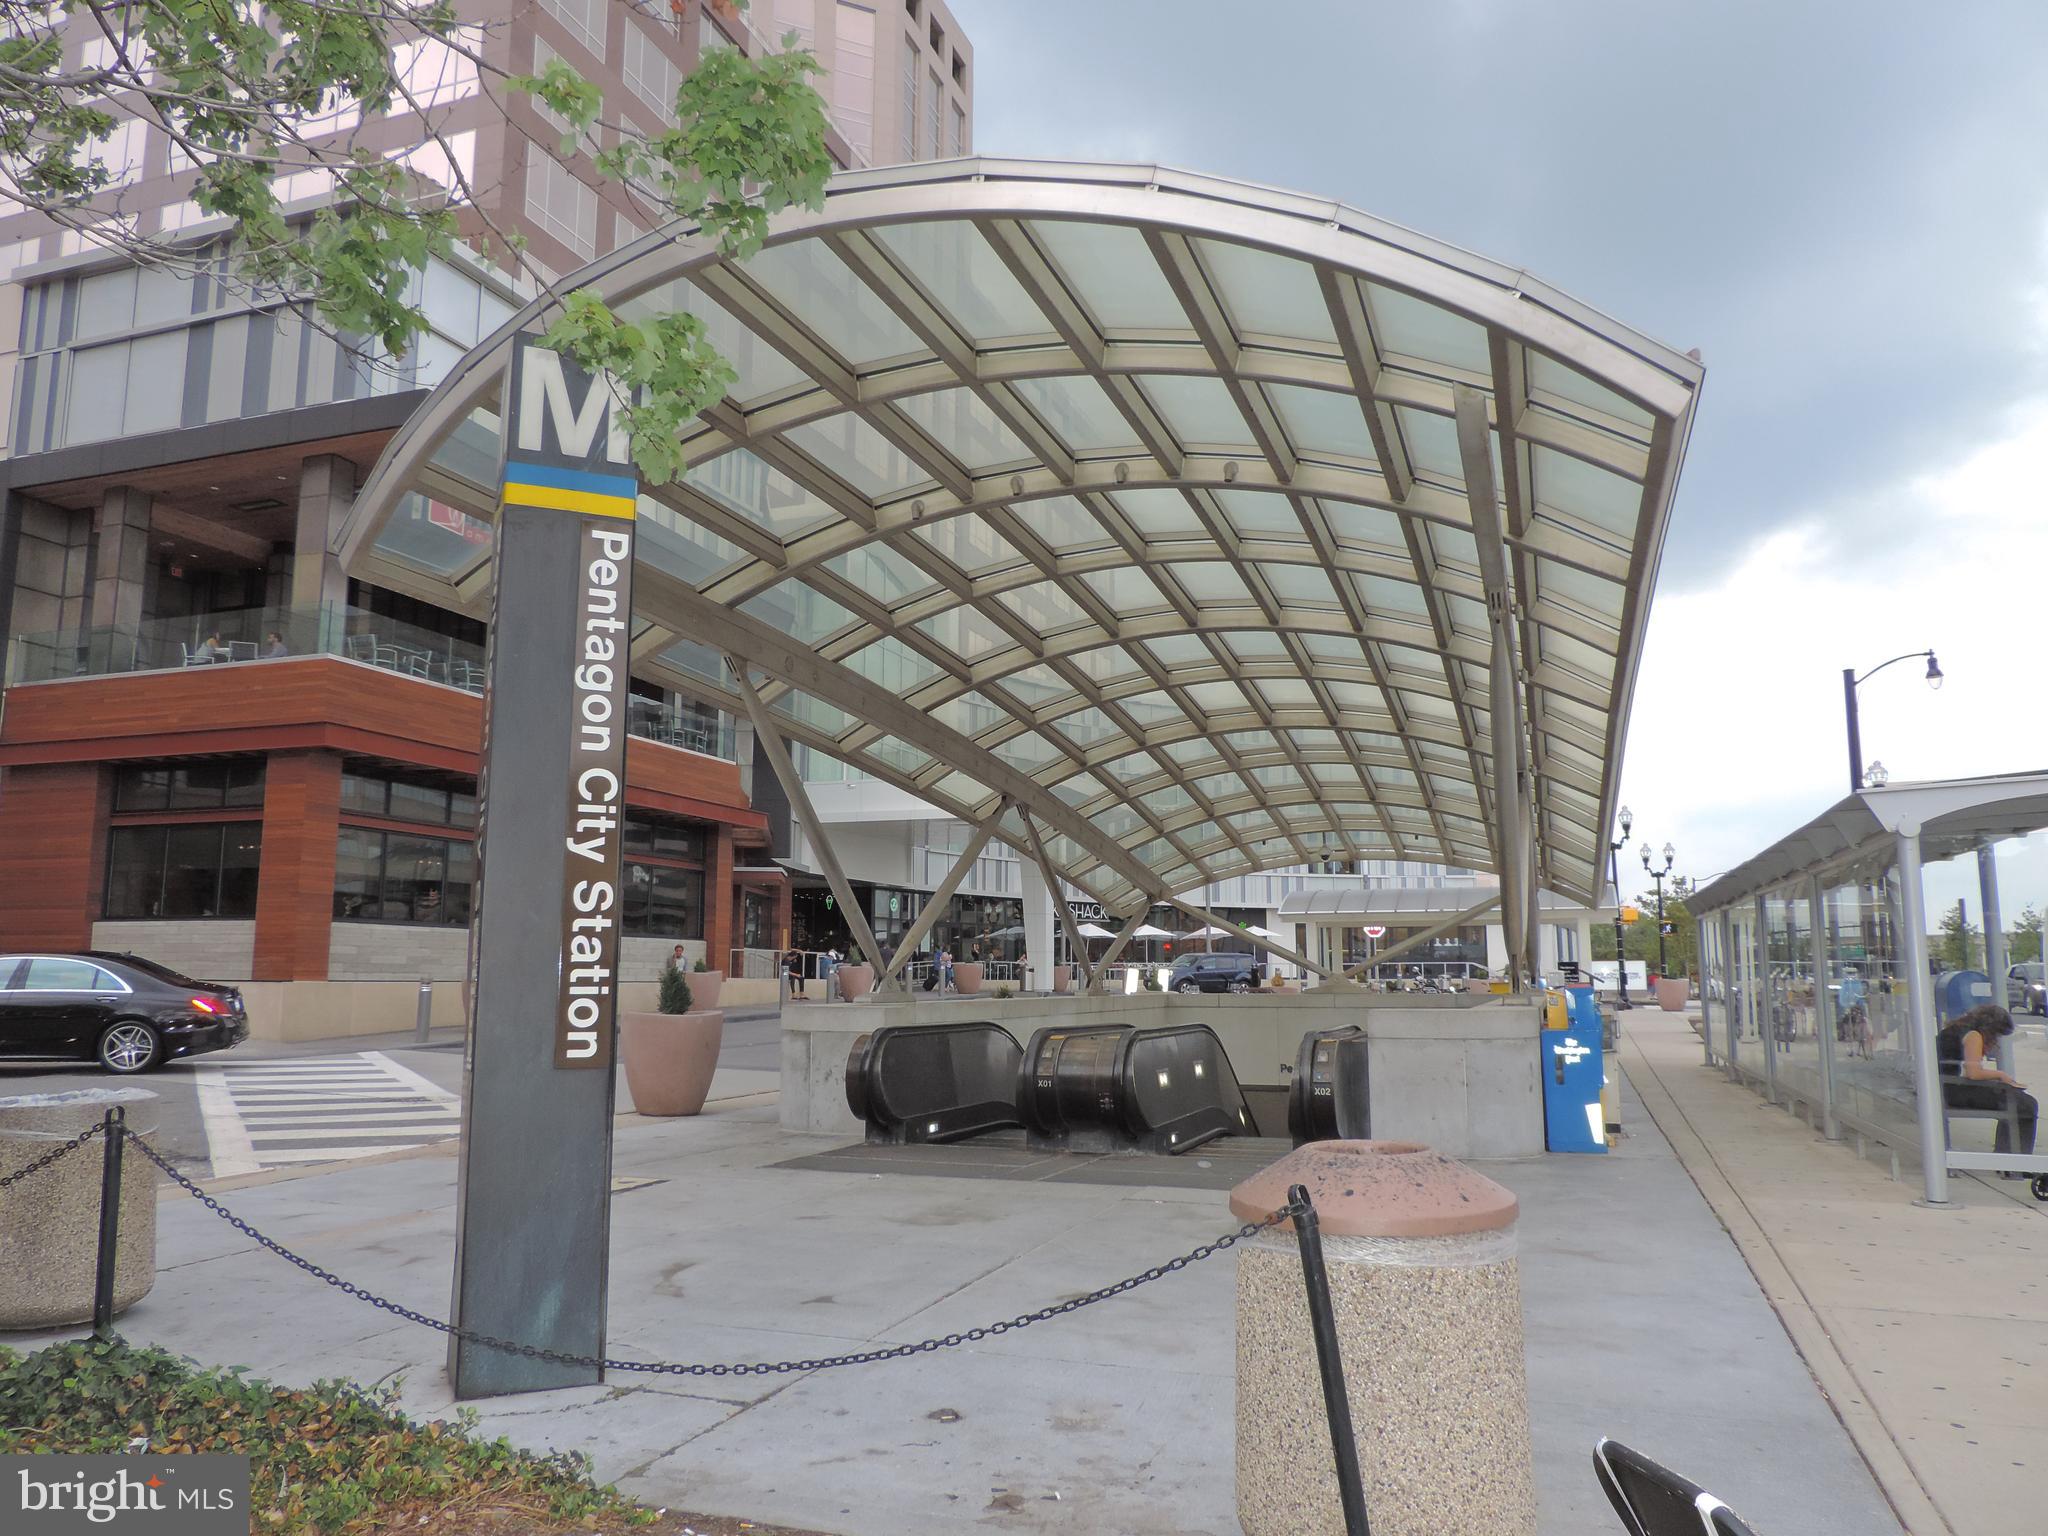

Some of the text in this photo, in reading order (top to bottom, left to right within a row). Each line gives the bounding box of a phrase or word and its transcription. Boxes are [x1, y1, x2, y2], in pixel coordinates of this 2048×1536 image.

[518, 346, 633, 464] M
[566, 529, 630, 1058] Pentagon City Station
[1069, 903, 1108, 919] SHACK
[1314, 1087, 1331, 1096] X02
